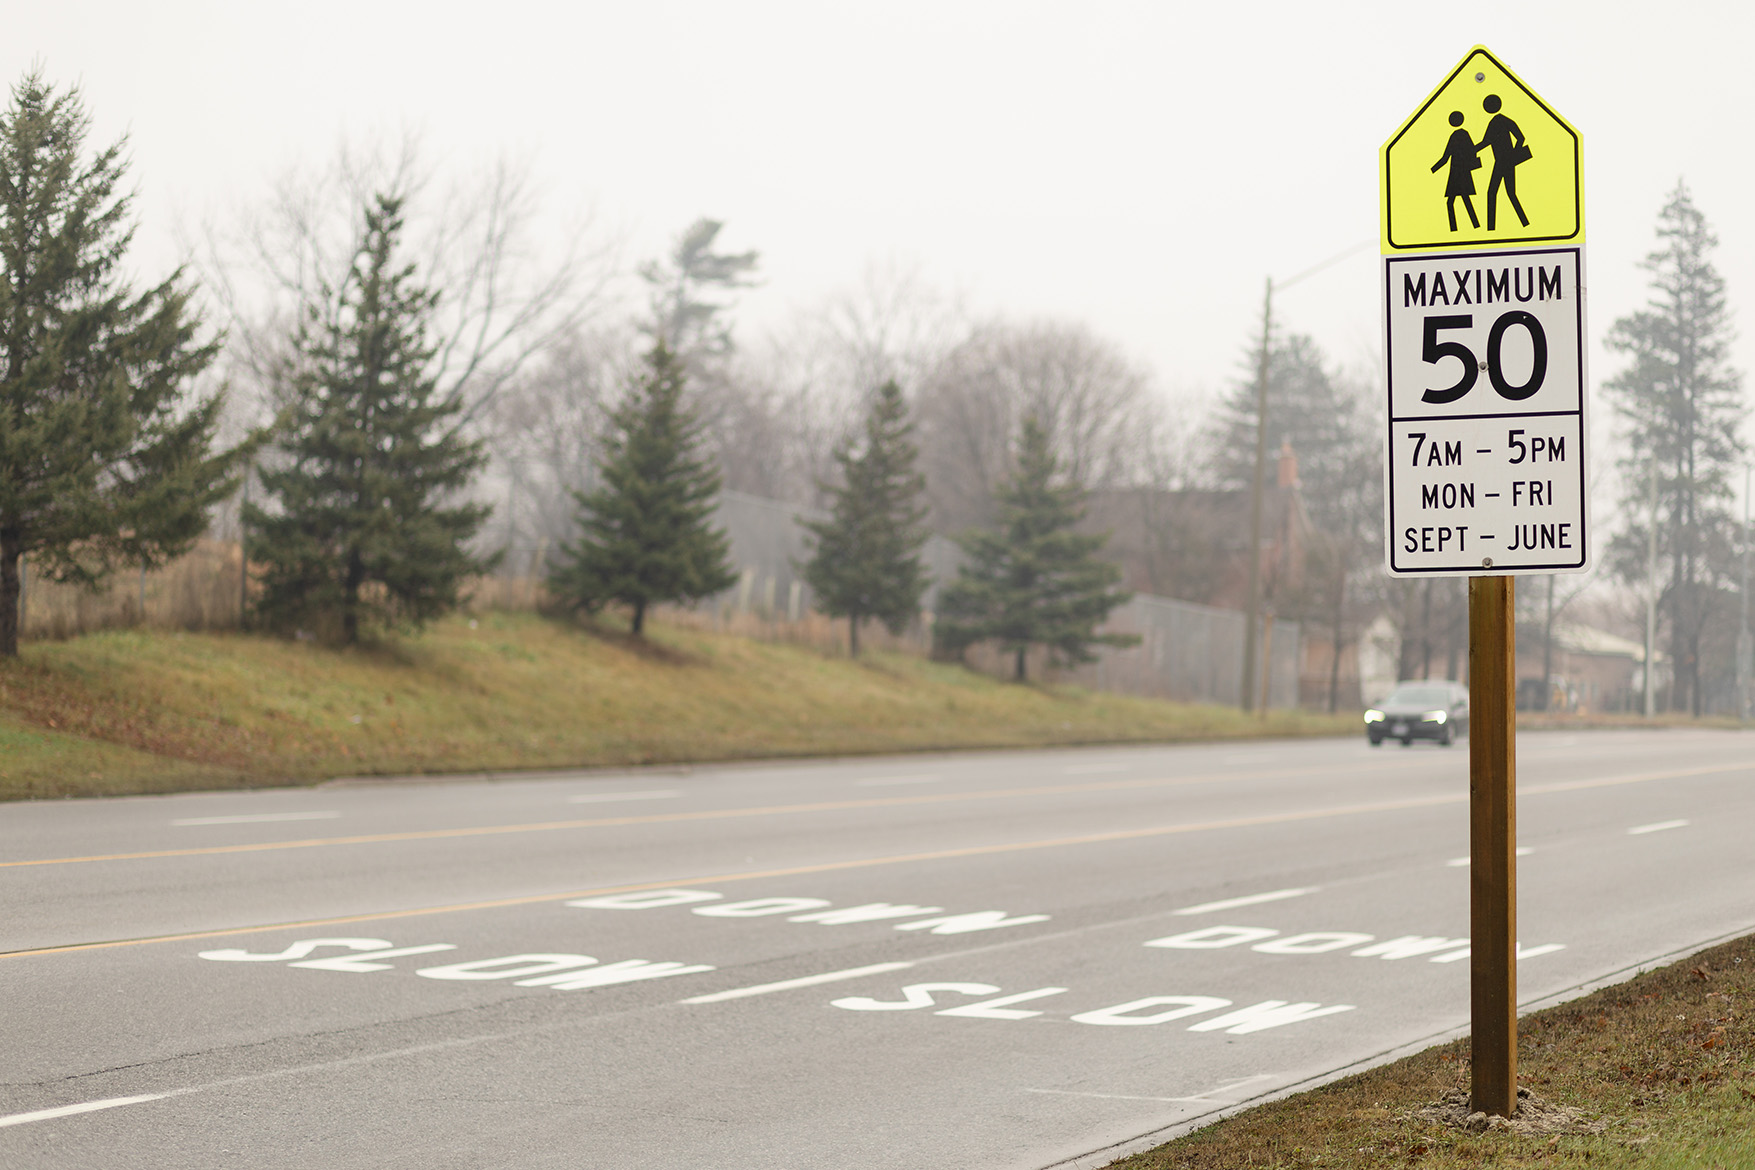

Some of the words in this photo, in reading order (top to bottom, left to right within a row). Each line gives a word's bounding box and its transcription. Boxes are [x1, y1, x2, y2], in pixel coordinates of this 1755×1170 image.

[1404, 265, 1562, 307] MAXIMUM
[1421, 310, 1548, 404] 50
[1407, 433, 1462, 467] 7AM
[1508, 429, 1566, 465] 5PM
[1422, 482, 1475, 509] MON
[1512, 480, 1553, 507] FRI
[1404, 526, 1469, 553] SEPT
[1507, 523, 1572, 551] JUNE
[564, 888, 1051, 935] DOWN
[197, 936, 717, 991] SLOW
[830, 980, 1357, 1035] SLOW
